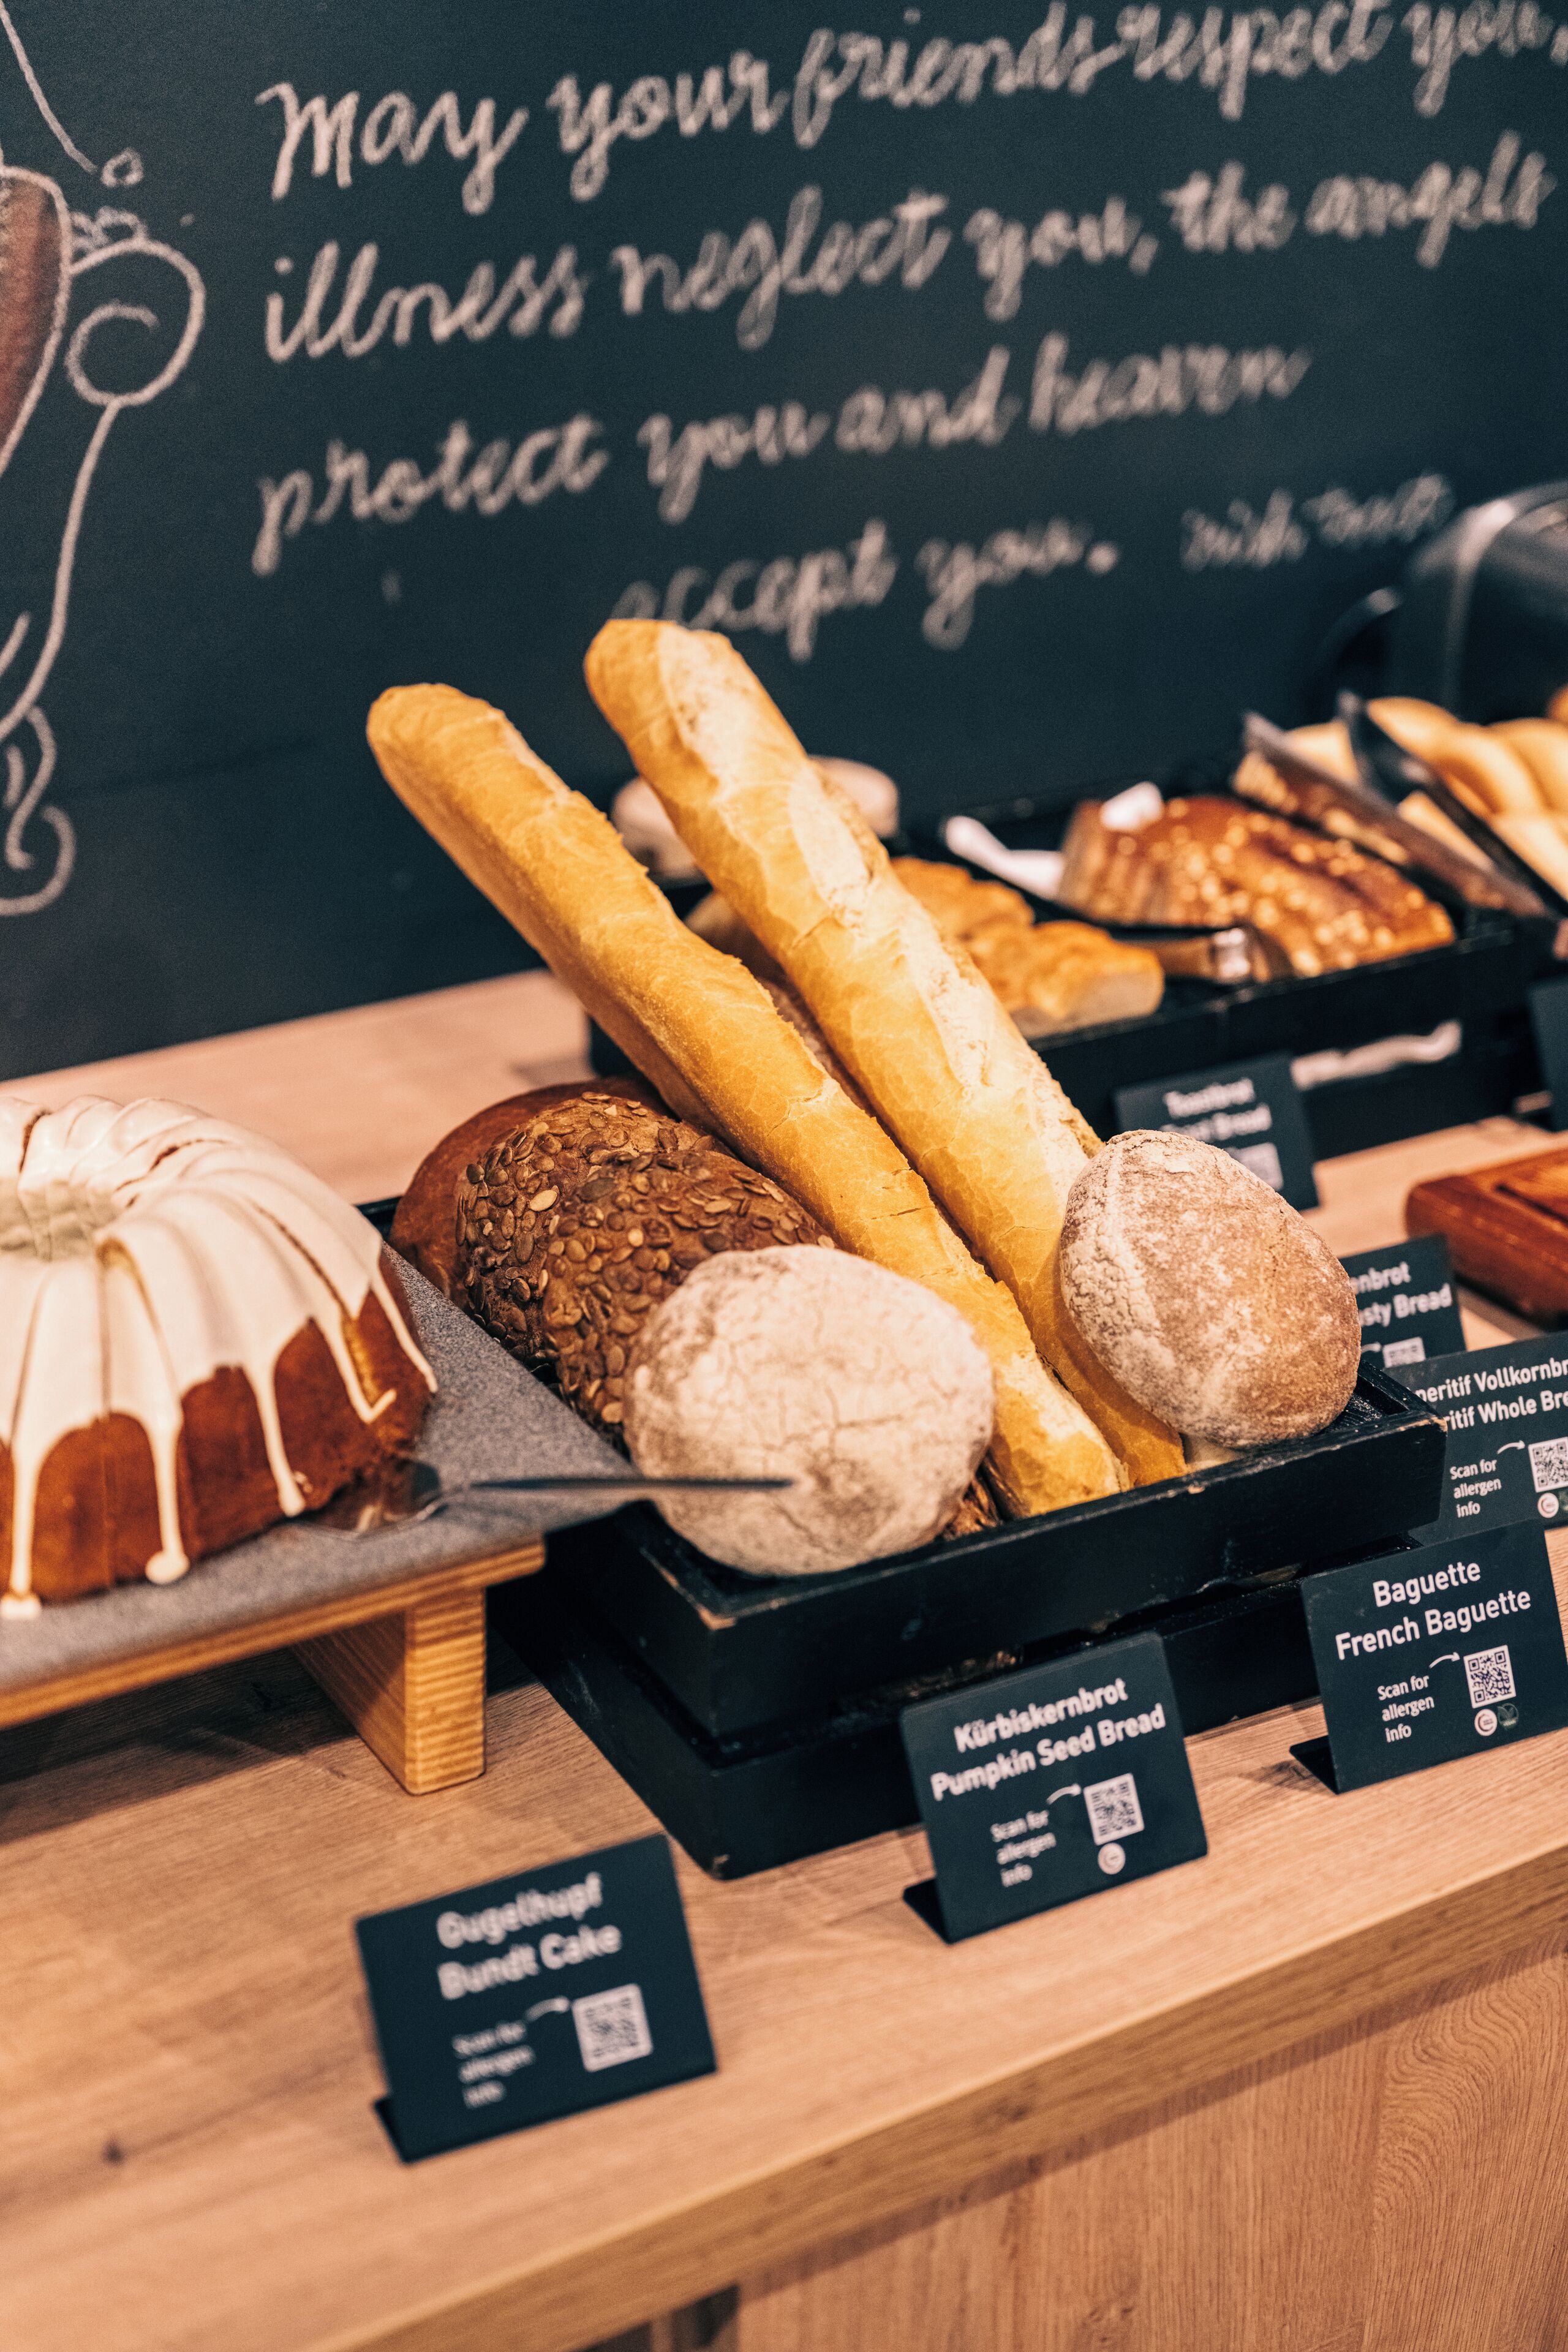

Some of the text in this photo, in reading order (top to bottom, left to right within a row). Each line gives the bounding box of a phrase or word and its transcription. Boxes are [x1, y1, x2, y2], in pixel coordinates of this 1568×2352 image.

[1472, 1355, 1568, 1394] Vollkornbr
[1477, 1394, 1538, 1425] Whole
[1449, 1458, 1498, 1480] Scan for
[1453, 1477, 1502, 1499] allergen
[1455, 1499, 1481, 1518] info
[1372, 1561, 1481, 1608] Baguette
[1335, 1590, 1531, 1660] French Baguette
[1376, 1674, 1430, 1702] Scan for
[954, 1678, 1128, 1753] Kürbiskernbrot
[1381, 1694, 1435, 1722] allergen
[1384, 1723, 1412, 1743] info
[930, 1702, 1167, 1801] Pumpkin Seed Bread
